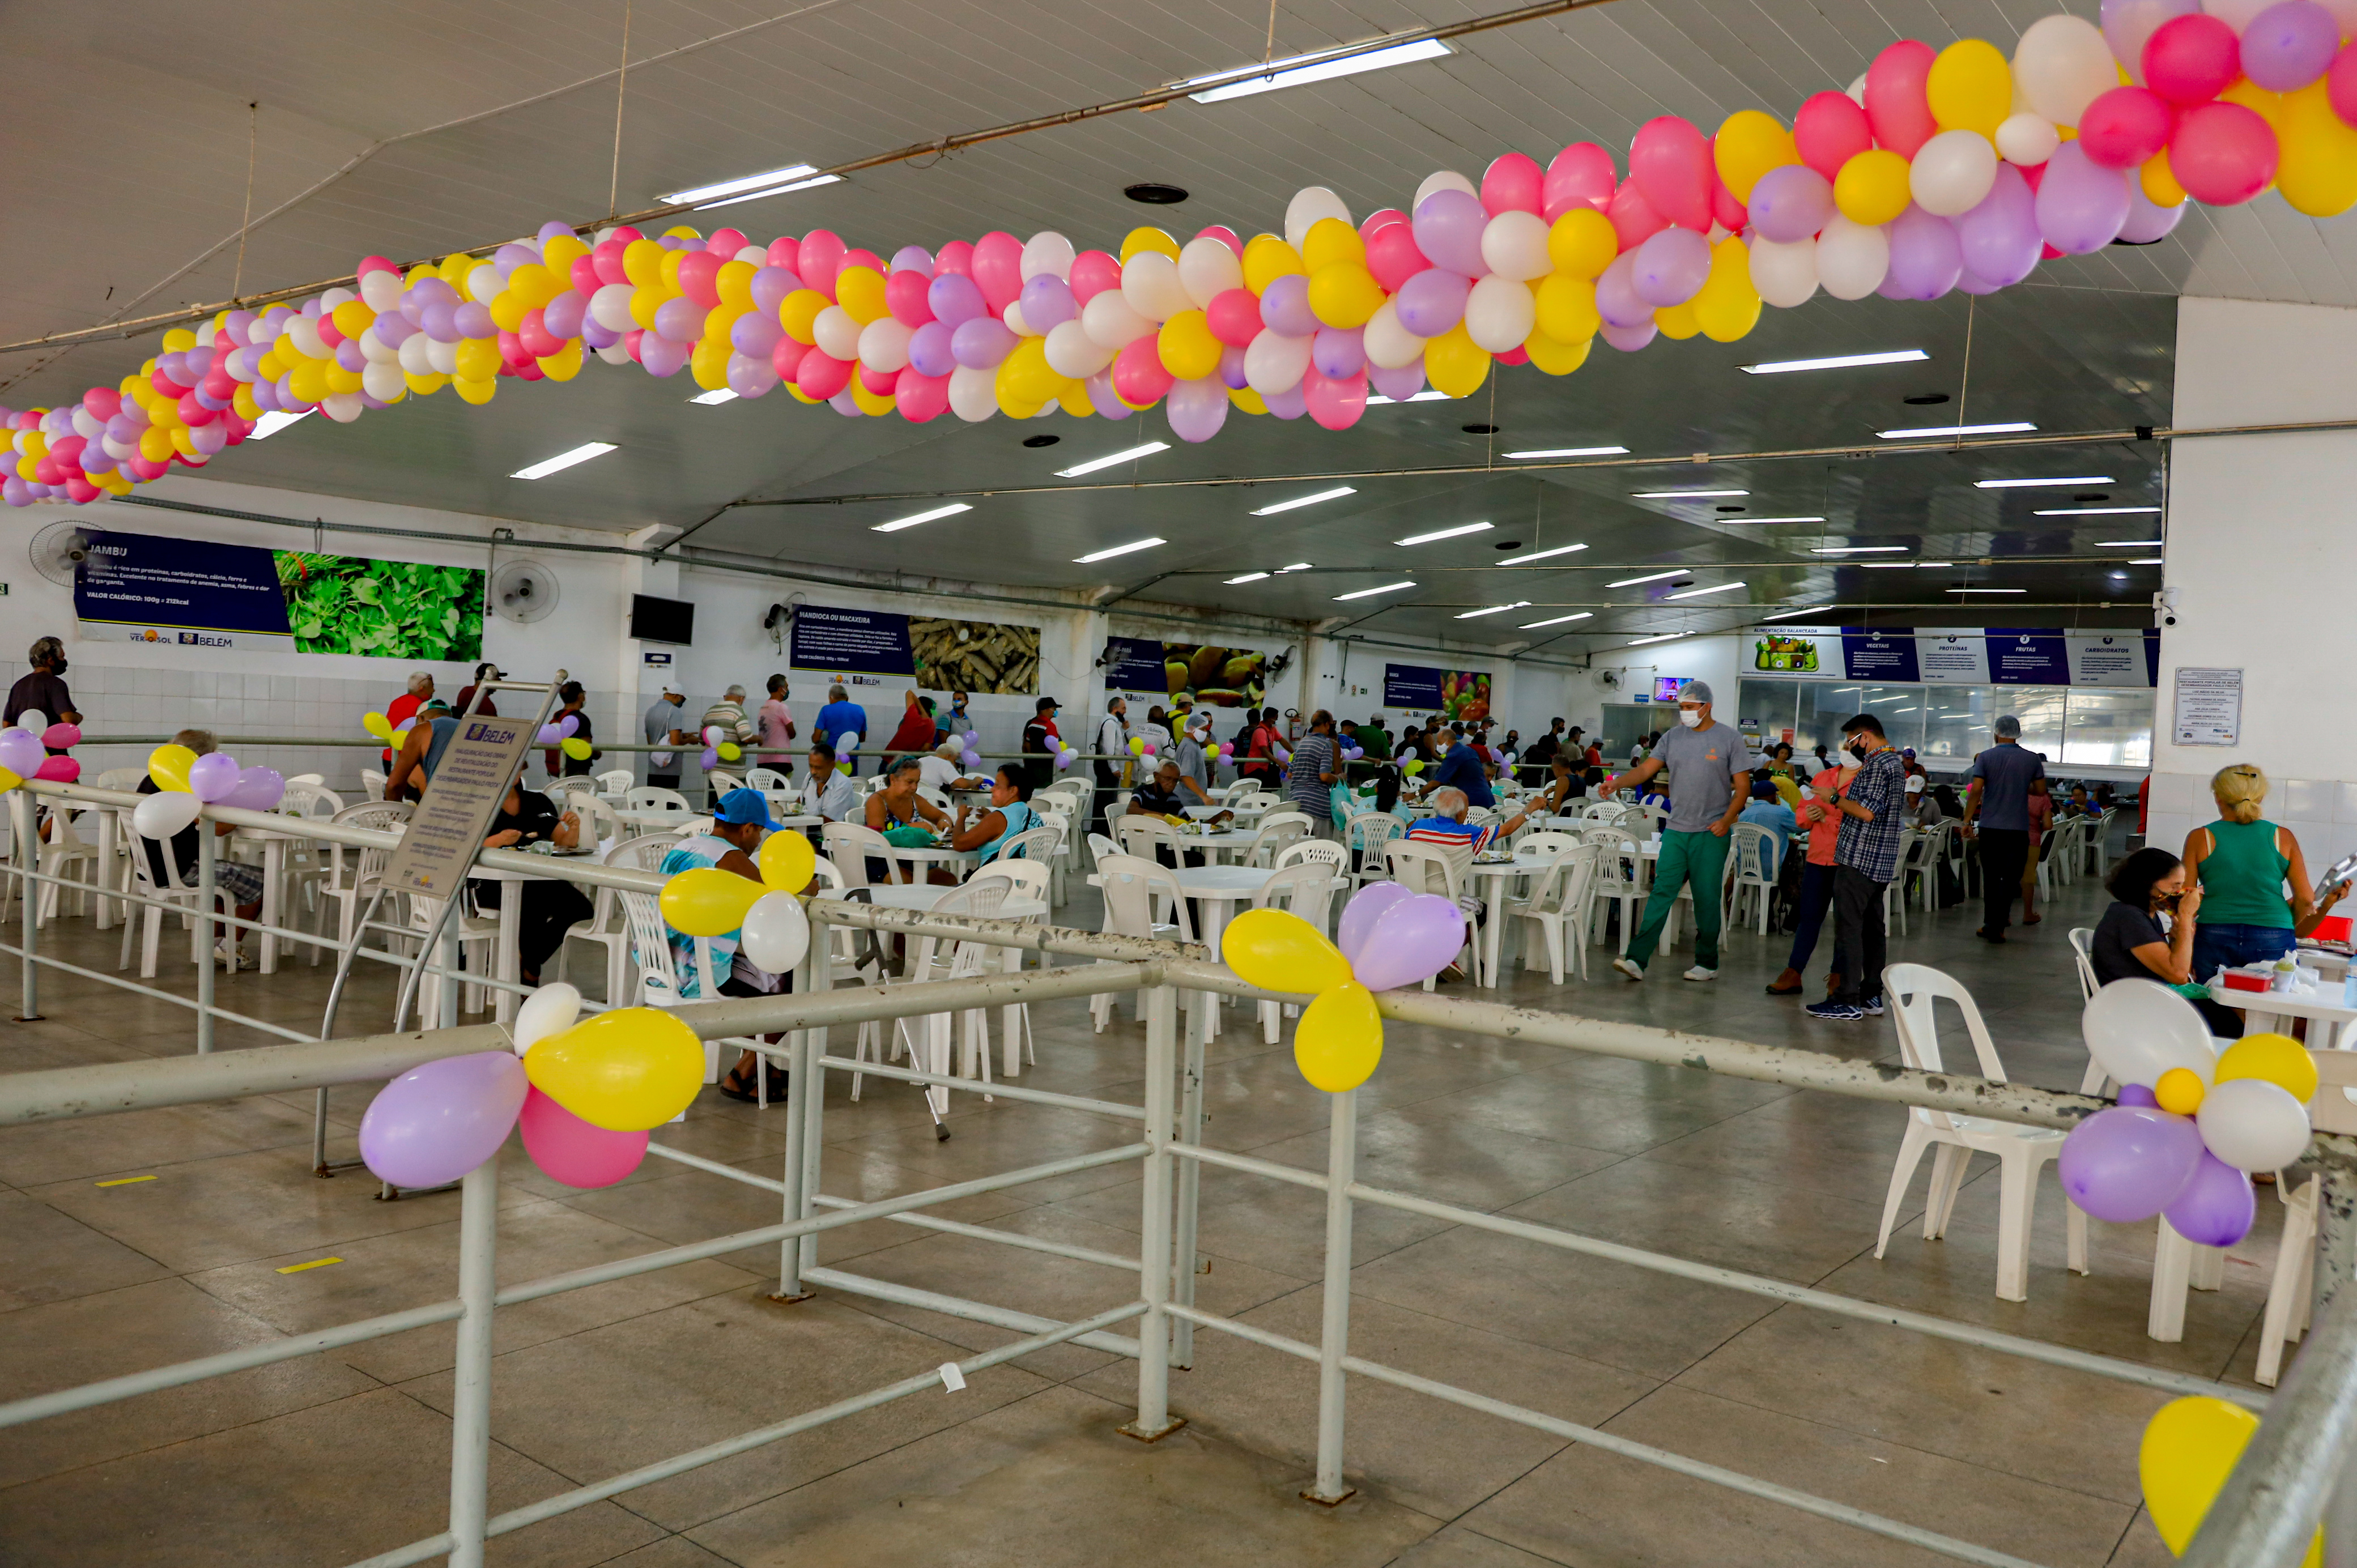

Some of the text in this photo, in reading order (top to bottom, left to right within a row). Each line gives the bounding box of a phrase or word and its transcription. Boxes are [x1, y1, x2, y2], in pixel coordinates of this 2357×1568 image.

[88, 544, 127, 556] JAMBU
[109, 593, 143, 601] CALÓRICO:
[799, 612, 829, 620] MANDIOCA
[839, 615, 870, 624] MACAXEIRA
[199, 637, 232, 647] BELÉM
[483, 730, 516, 744] BELÉM
[460, 759, 491, 767] REVITALIZAÇÃO
[448, 766, 476, 775] RESTAURANTE
